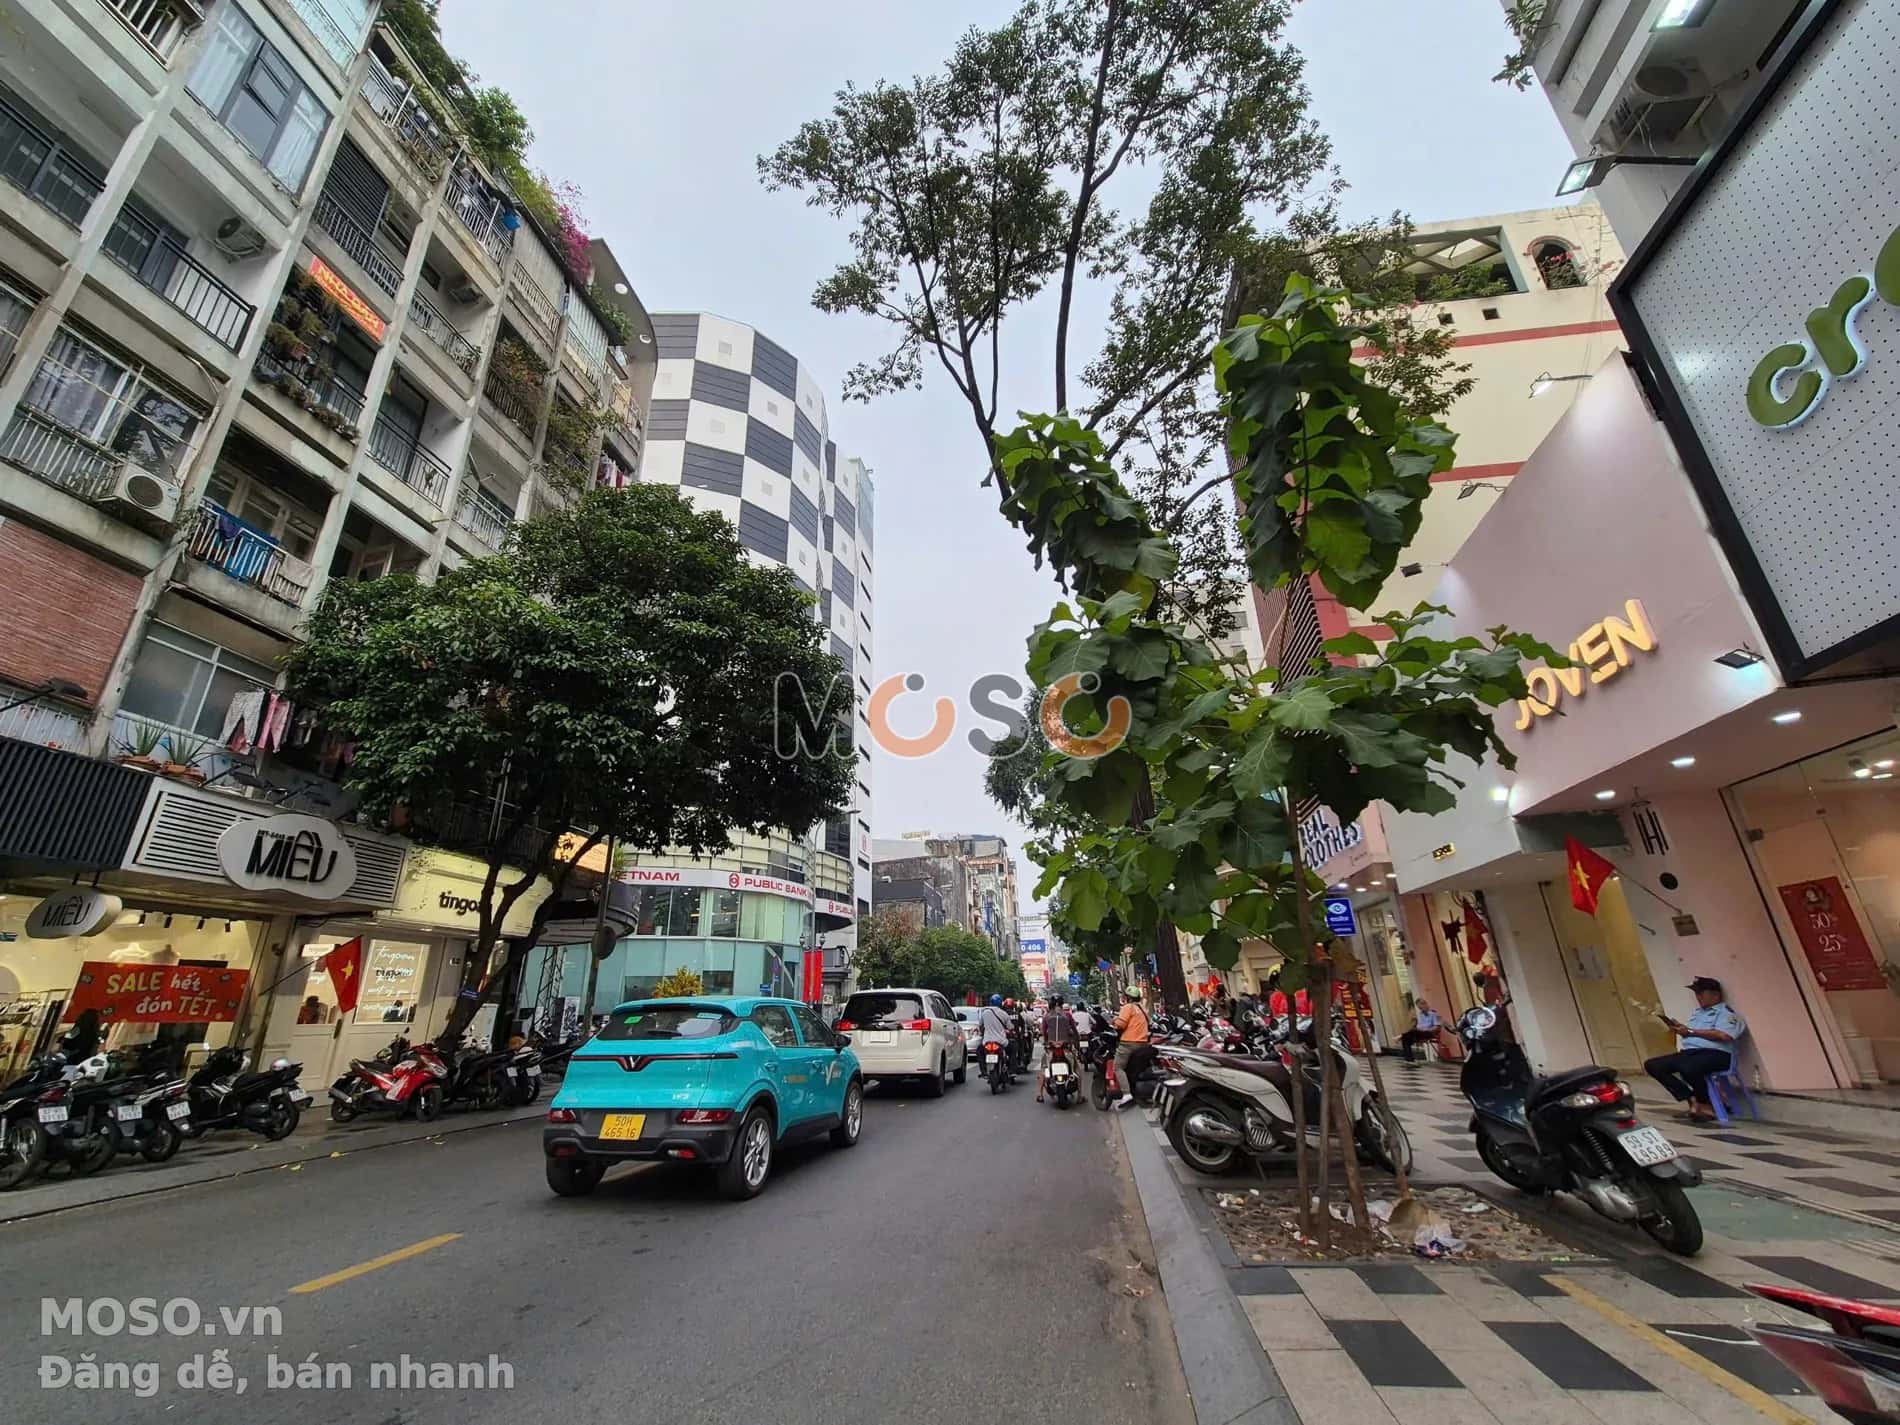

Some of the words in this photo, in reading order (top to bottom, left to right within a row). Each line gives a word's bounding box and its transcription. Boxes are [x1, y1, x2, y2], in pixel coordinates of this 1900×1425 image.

[744, 877, 783, 891] PUBLIC
[785, 884, 808, 897] BANK
[439, 890, 481, 916] tingo
[106, 971, 164, 995] SALE
[135, 996, 173, 1015] đón
